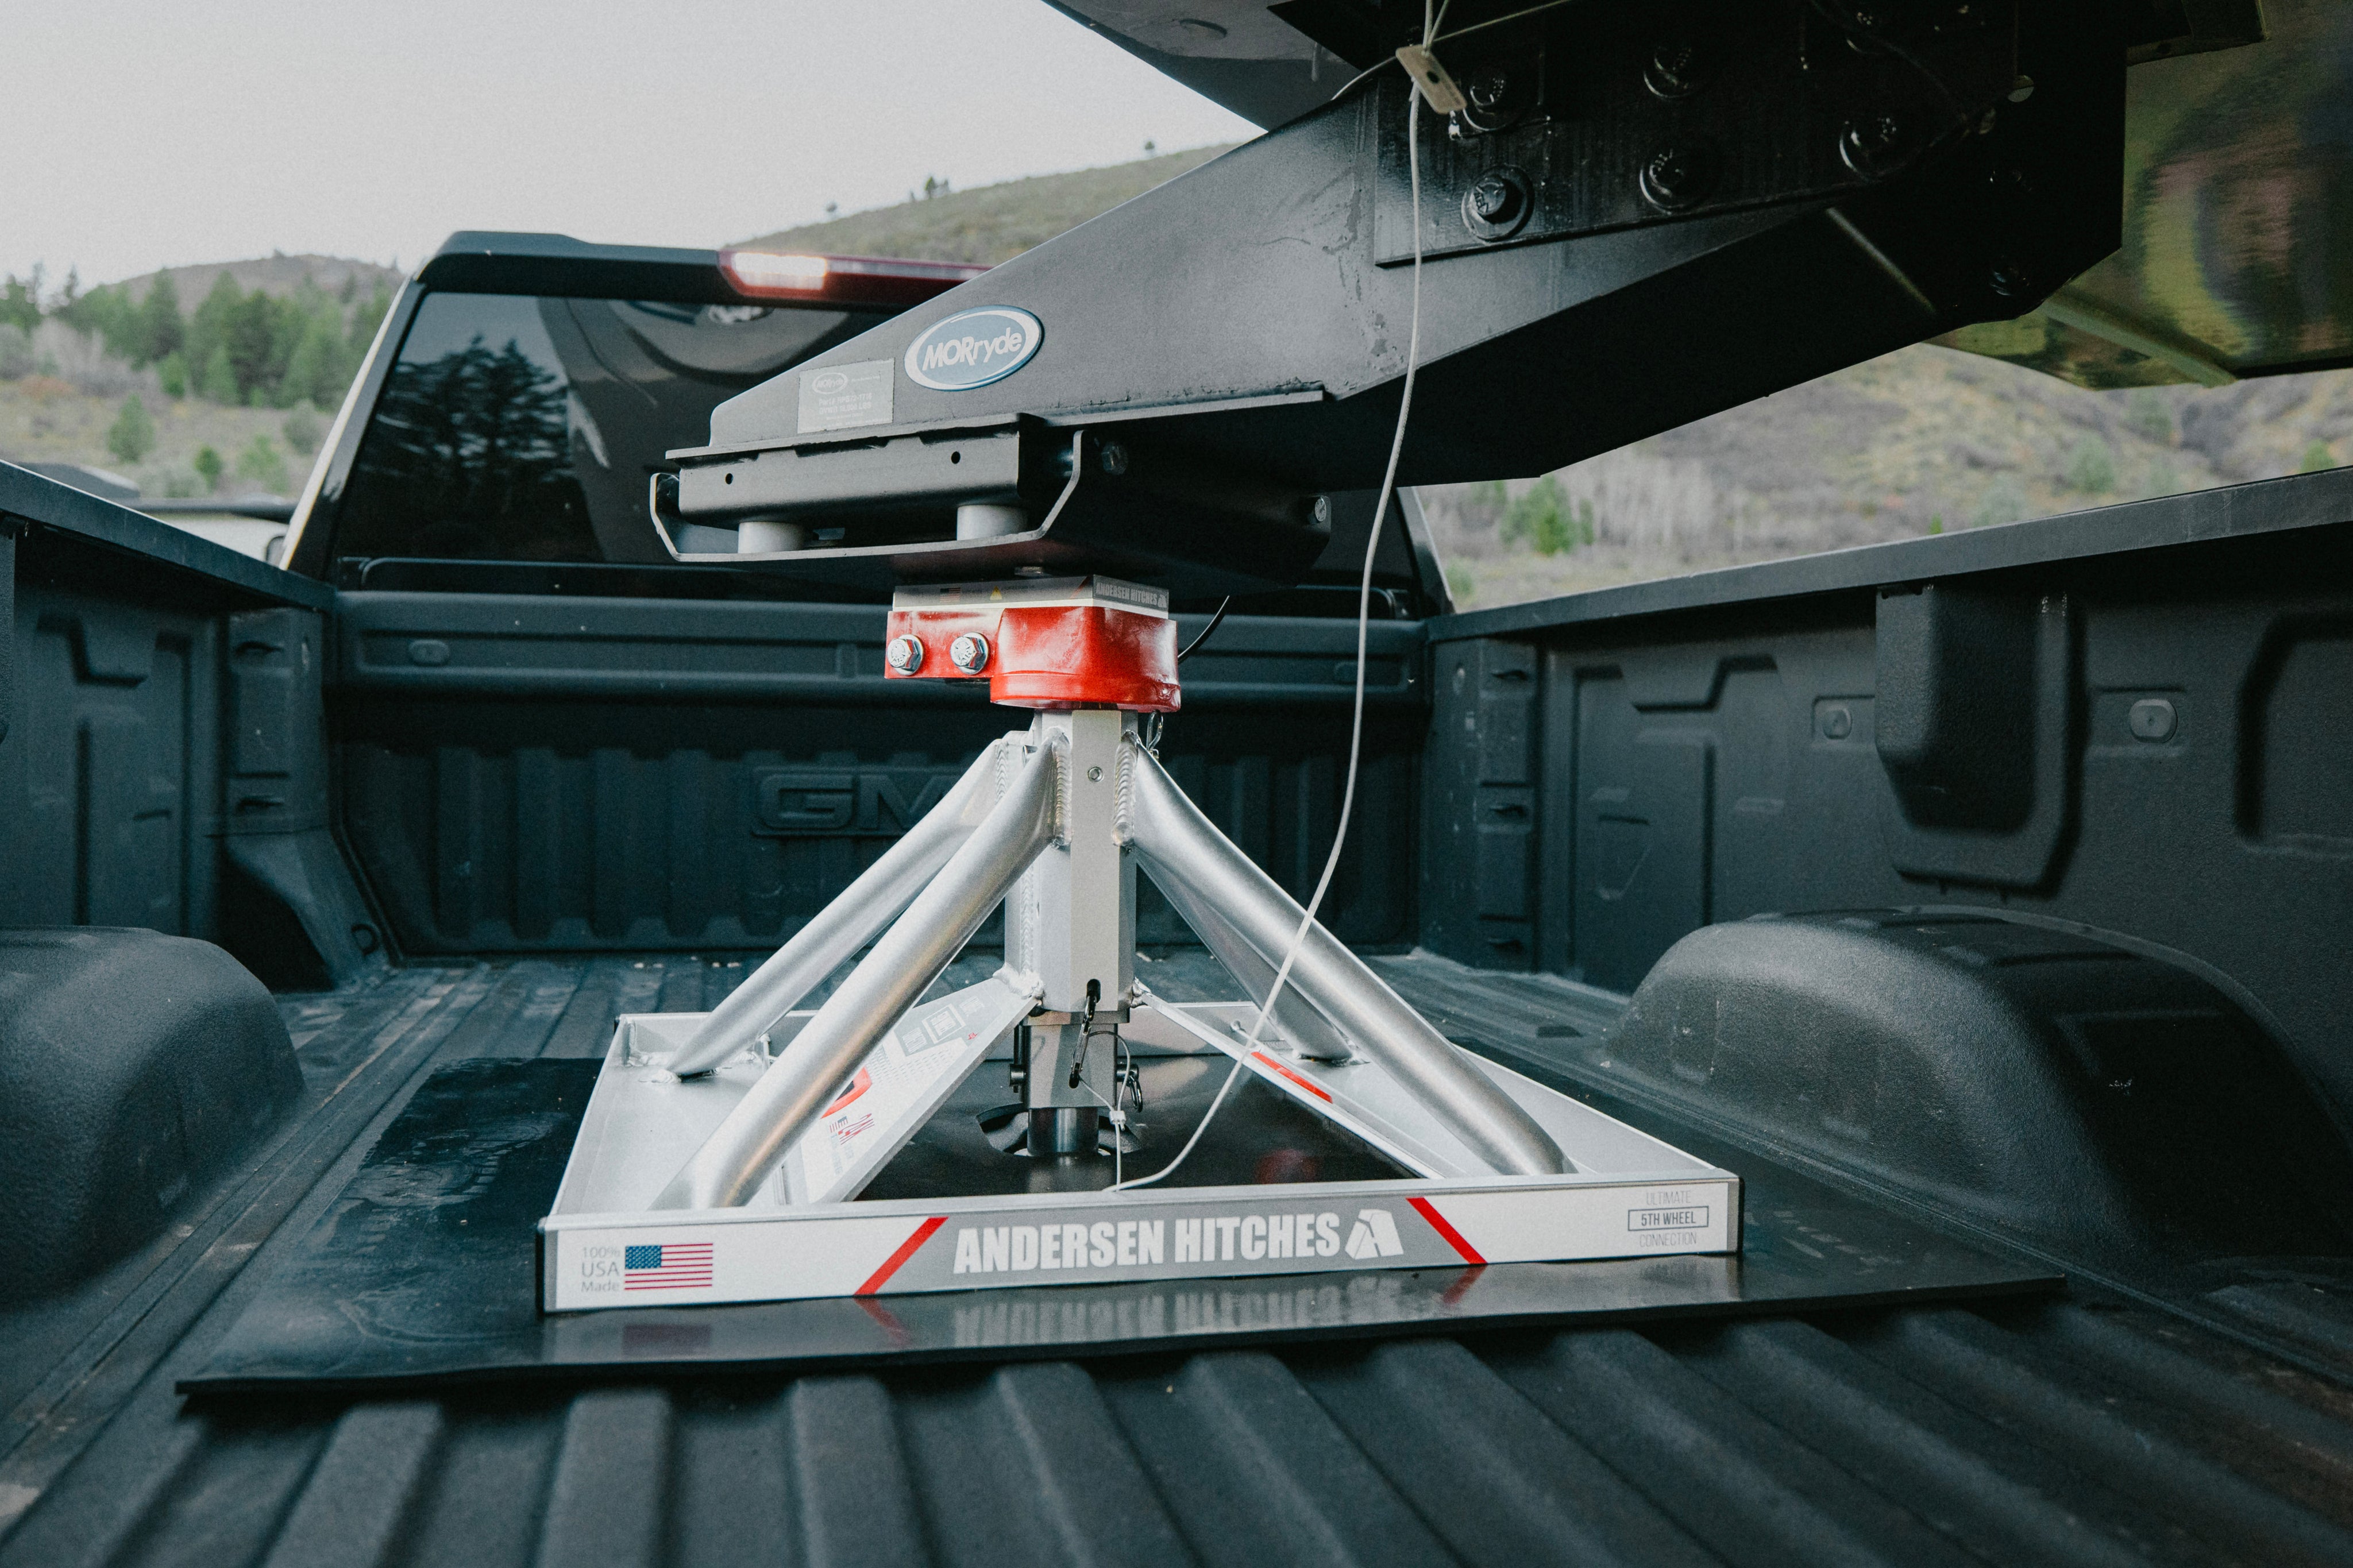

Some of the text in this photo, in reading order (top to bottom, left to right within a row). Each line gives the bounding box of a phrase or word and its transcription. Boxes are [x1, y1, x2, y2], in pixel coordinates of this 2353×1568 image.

[922, 327, 1022, 370] MORryde
[1096, 582, 1157, 605] ANDERSEN HITCHES
[759, 773, 962, 829] GM
[1646, 1191, 1691, 1205] ULTIMATE
[1641, 1211, 1696, 1226] 5TH WHEEL
[953, 1212, 1340, 1274] ANDERSEN HITCHES
[1639, 1232, 1696, 1248] CONNECTION
[583, 1246, 620, 1258] 100%
[581, 1261, 619, 1277] USA
[580, 1279, 619, 1292] Made
